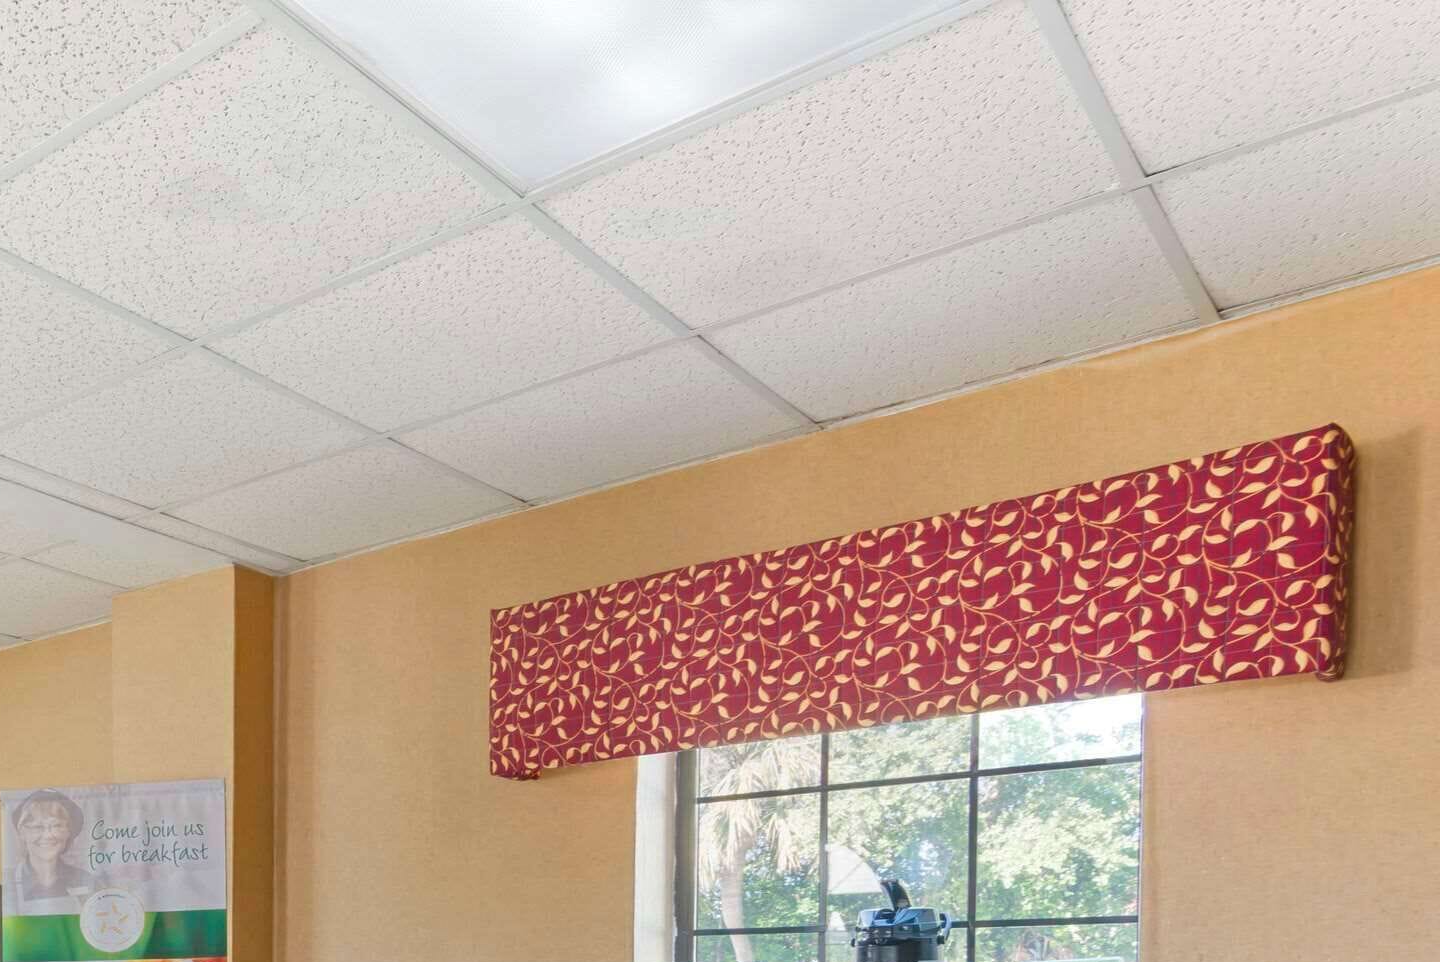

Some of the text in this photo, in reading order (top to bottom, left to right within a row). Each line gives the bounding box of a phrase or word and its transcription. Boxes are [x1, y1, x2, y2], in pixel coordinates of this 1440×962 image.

[91, 819, 204, 846] Come join us
[88, 841, 208, 870] for breakfast
